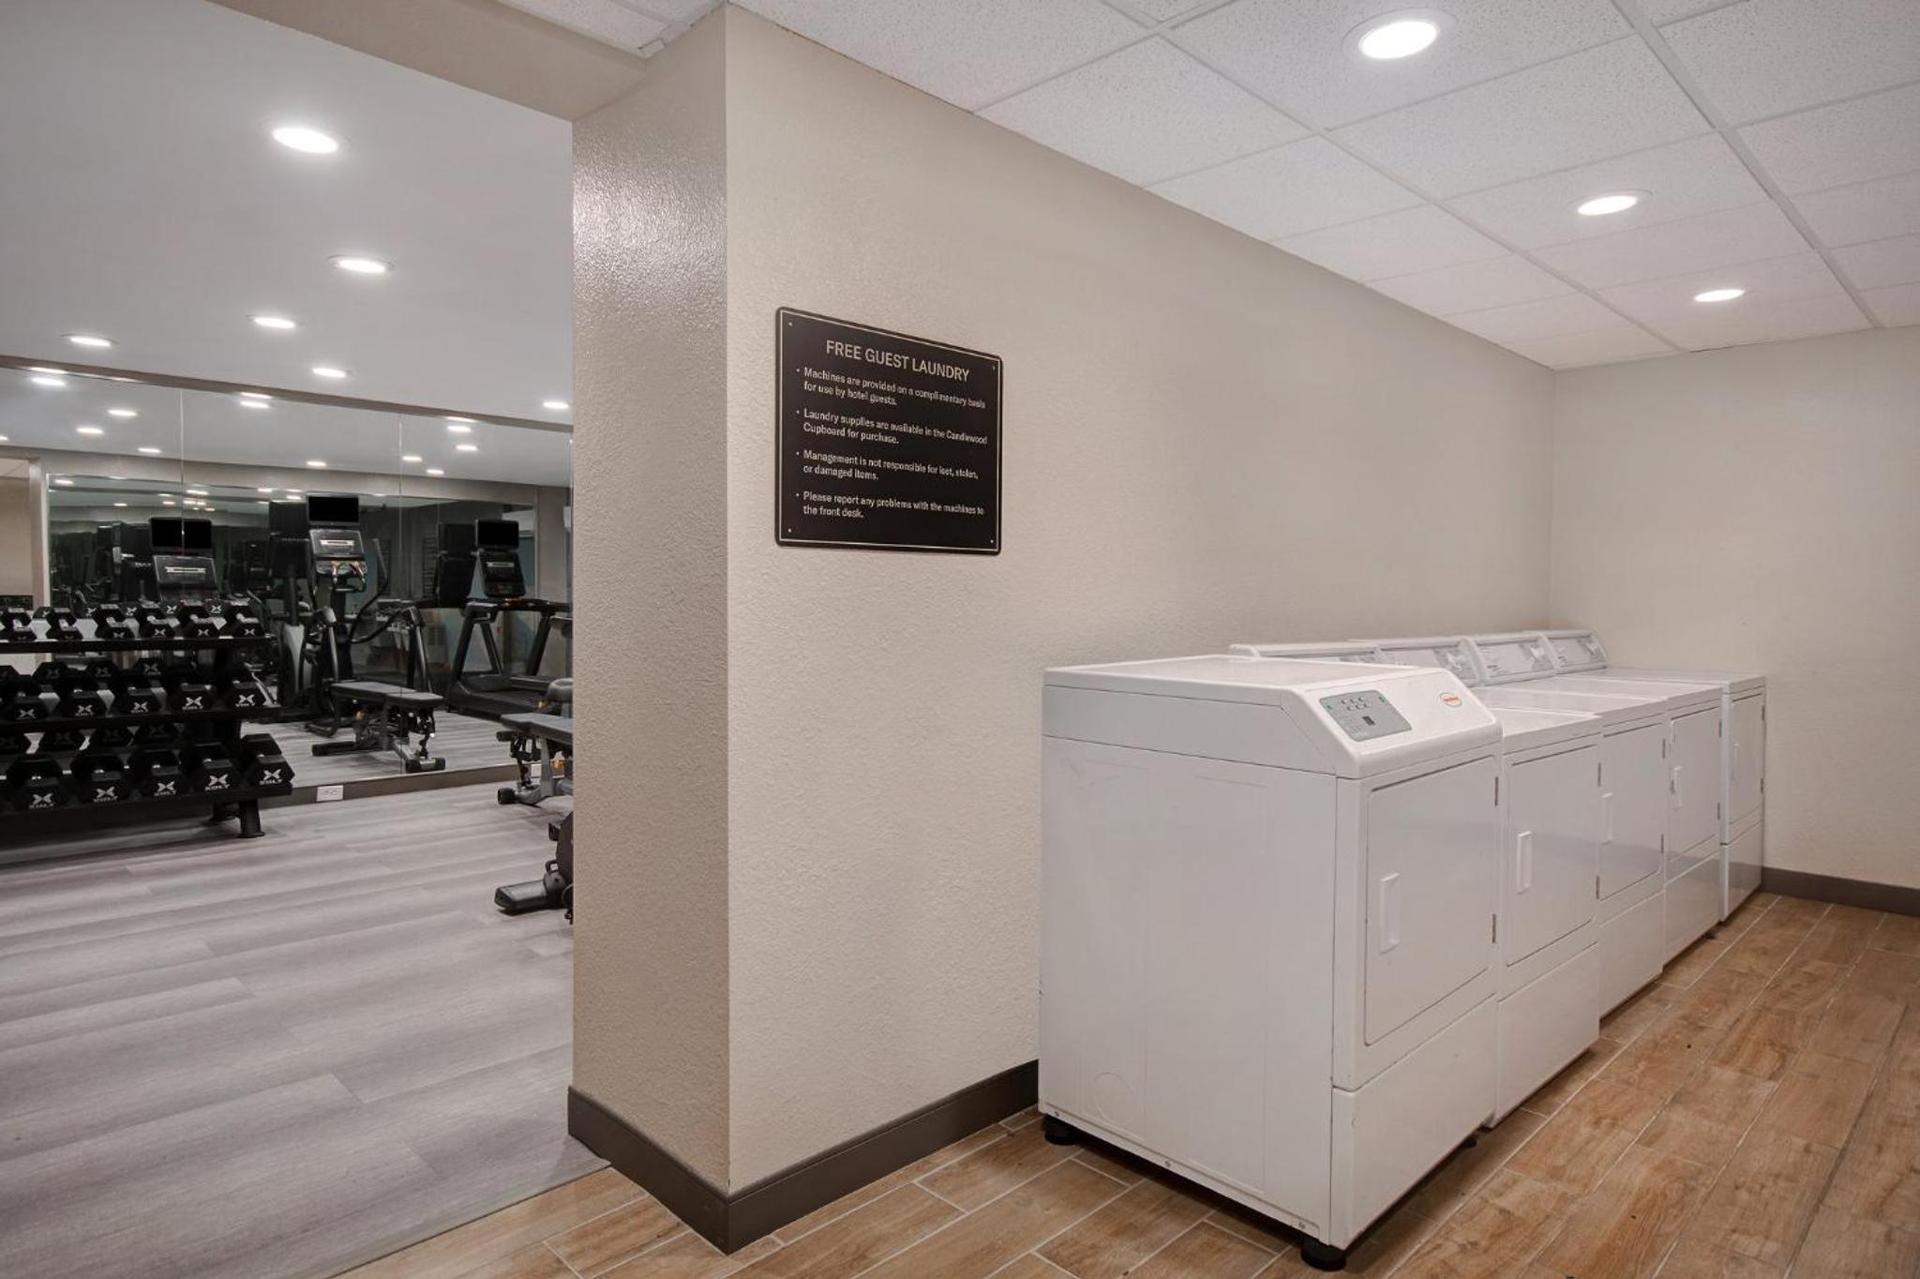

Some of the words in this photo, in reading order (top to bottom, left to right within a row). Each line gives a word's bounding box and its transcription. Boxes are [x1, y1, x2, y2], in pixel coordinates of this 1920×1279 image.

[826, 340, 862, 360] FREE
[865, 348, 910, 369] GUEST
[912, 358, 970, 381] LAUNDRY
[804, 366, 846, 384] Machines
[847, 376, 861, 386] are
[862, 379, 896, 393] provided
[897, 386, 907, 396] on
[908, 387, 914, 396] a
[968, 398, 986, 409] basis
[804, 381, 817, 391] for
[818, 385, 834, 395] use
[835, 385, 846, 398] by
[847, 388, 869, 400] hotel
[870, 393, 898, 406] guests.
[803, 422, 846, 437] Cupboard
[847, 427, 859, 438] for
[860, 431, 900, 445] purchase.
[804, 407, 839, 424] Laundry
[841, 416, 875, 427] supplies
[876, 421, 889, 430] are
[890, 423, 924, 435] available
[925, 426, 933, 436] in
[933, 428, 945, 438] the
[946, 430, 988, 445] Candlewood
[803, 449, 859, 464] Management
[859, 456, 867, 466] is
[868, 459, 882, 468] not
[883, 460, 926, 473] responsible
[927, 464, 938, 474] for
[939, 466, 954, 477] lost,
[955, 468, 979, 479] stolen,
[803, 465, 813, 474] or
[814, 465, 853, 479] damaged
[854, 469, 879, 480] items.
[803, 491, 832, 503] Please
[834, 495, 859, 506] report
[860, 498, 875, 508] any
[876, 498, 912, 509] problems
[913, 501, 929, 511] with
[930, 502, 942, 512] the
[943, 504, 976, 515] machines
[977, 506, 984, 515] to
[803, 505, 818, 515] the
[819, 506, 840, 517] front
[841, 508, 864, 518] desk.
